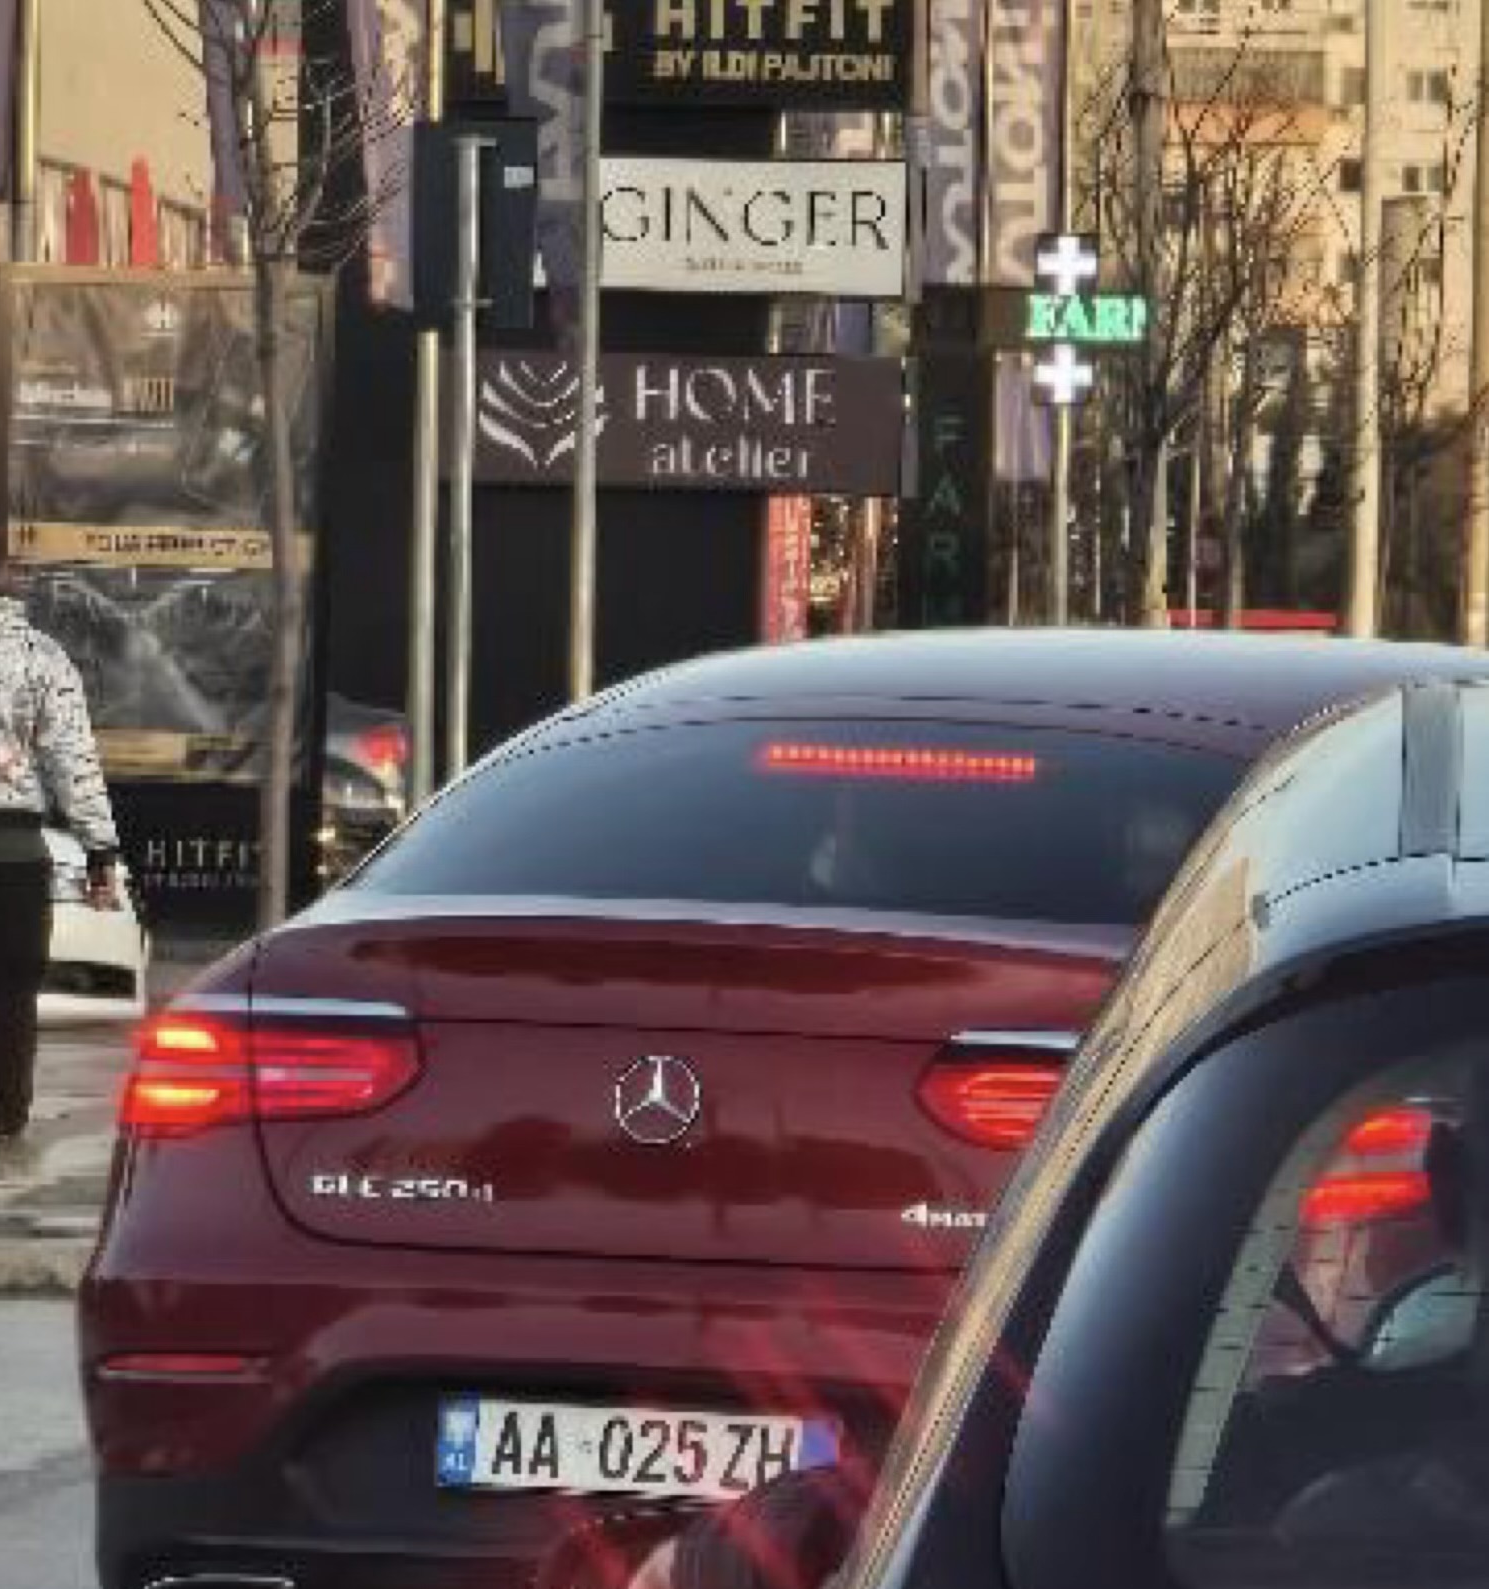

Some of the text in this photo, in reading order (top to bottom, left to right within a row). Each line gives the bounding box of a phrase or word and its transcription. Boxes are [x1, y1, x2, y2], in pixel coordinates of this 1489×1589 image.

[653, 0, 894, 40] HITFIT
[654, 50, 694, 78] BY
[703, 52, 759, 79] ILDI
[602, 186, 890, 250] GINGER
[635, 365, 838, 425] HOME
[651, 435, 811, 479] atelier
[901, 1200, 988, 1230] 4MAT
[490, 1411, 559, 1480] AA
